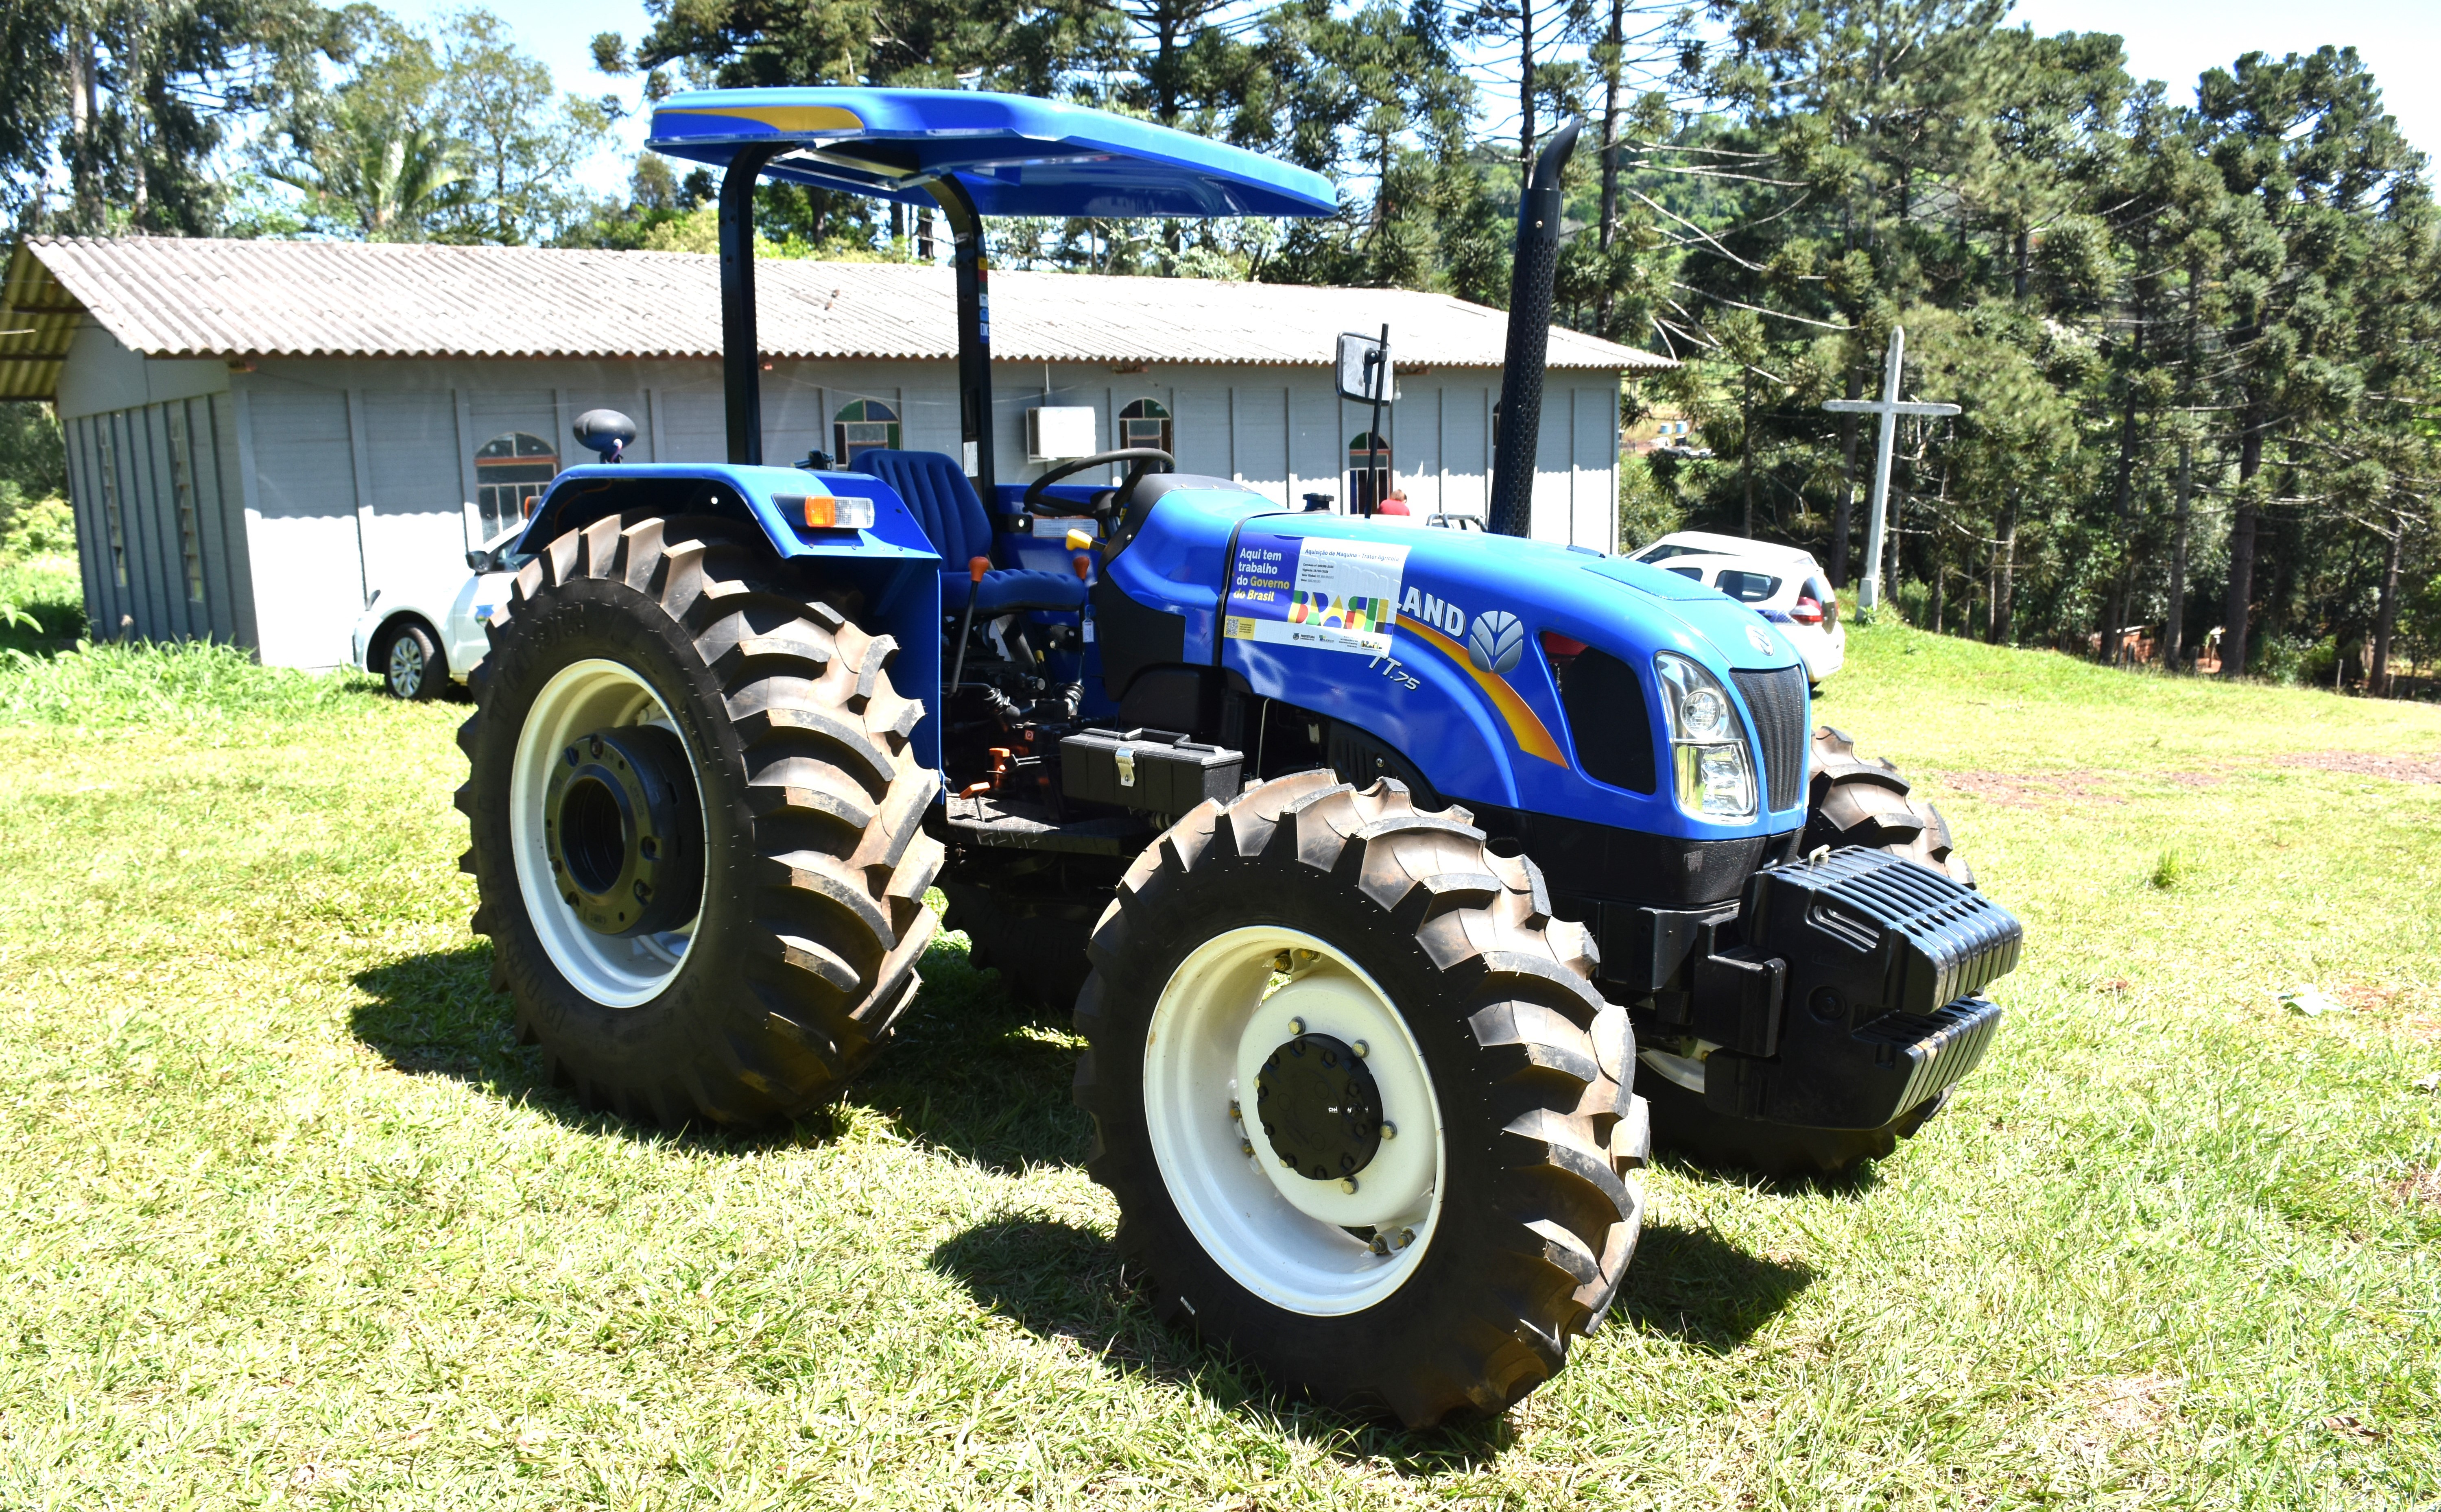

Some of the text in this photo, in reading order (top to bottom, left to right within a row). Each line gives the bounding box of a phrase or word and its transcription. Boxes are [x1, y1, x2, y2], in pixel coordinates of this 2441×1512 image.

[1240, 548, 1282, 561] Aqui tem
[1238, 562, 1277, 574] trabalho
[1237, 575, 1290, 589] do Governo
[1233, 589, 1275, 602] do Brasil
[1287, 590, 1395, 635] BRASIL
[1397, 586, 1466, 638] AND
